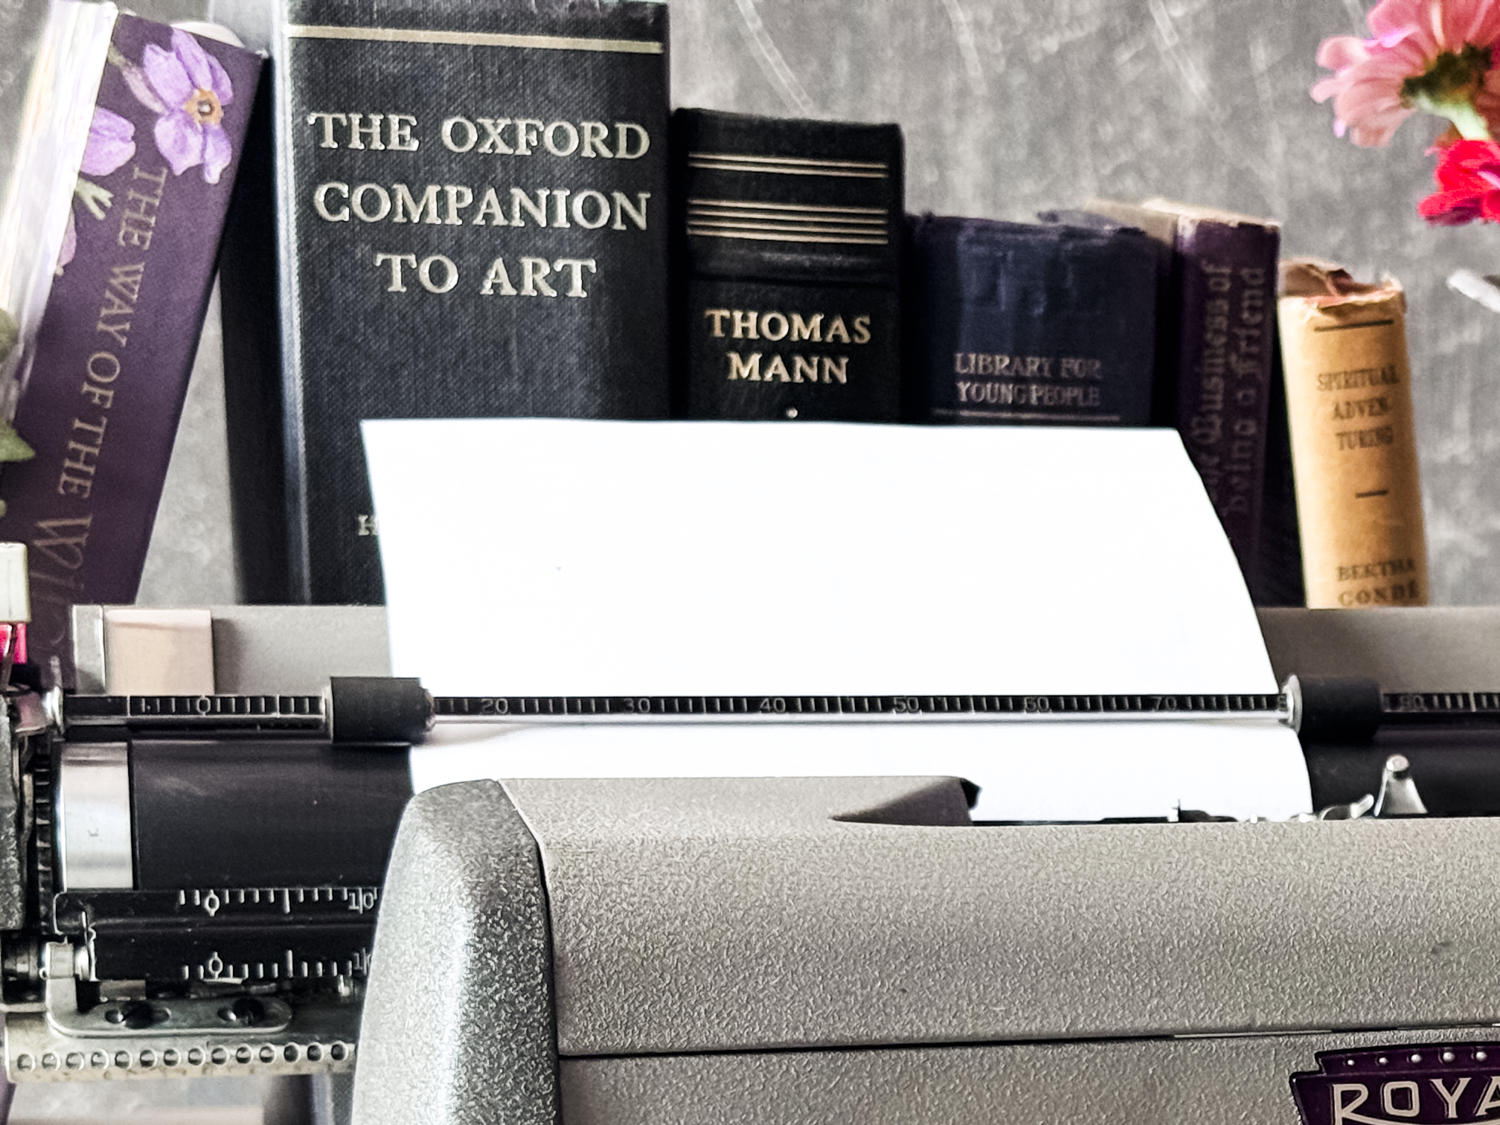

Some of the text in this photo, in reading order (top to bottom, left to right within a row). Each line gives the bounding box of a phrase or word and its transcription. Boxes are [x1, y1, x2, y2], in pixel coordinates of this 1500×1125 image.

[307, 113, 650, 160] THE OXFORD
[118, 166, 168, 250] THE
[314, 182, 650, 230] COMPANION
[374, 254, 597, 298] TO ART
[97, 262, 146, 347] WAY
[704, 308, 871, 344] THOMAS
[81, 351, 121, 408] OF
[726, 352, 849, 384] MANN
[954, 353, 1101, 379] LIBRARY FOR
[956, 381, 1101, 407] YOUNG PEOPLE
[57, 417, 108, 498] THE
[1336, 559, 1416, 581] BERTHA
[481, 698, 509, 714] 20
[624, 697, 651, 714] 30
[759, 697, 787, 713] 40
[893, 696, 920, 712] 50
[1024, 696, 1051, 712] 60
[1152, 696, 1179, 711] 70
[348, 892, 375, 910] 10
